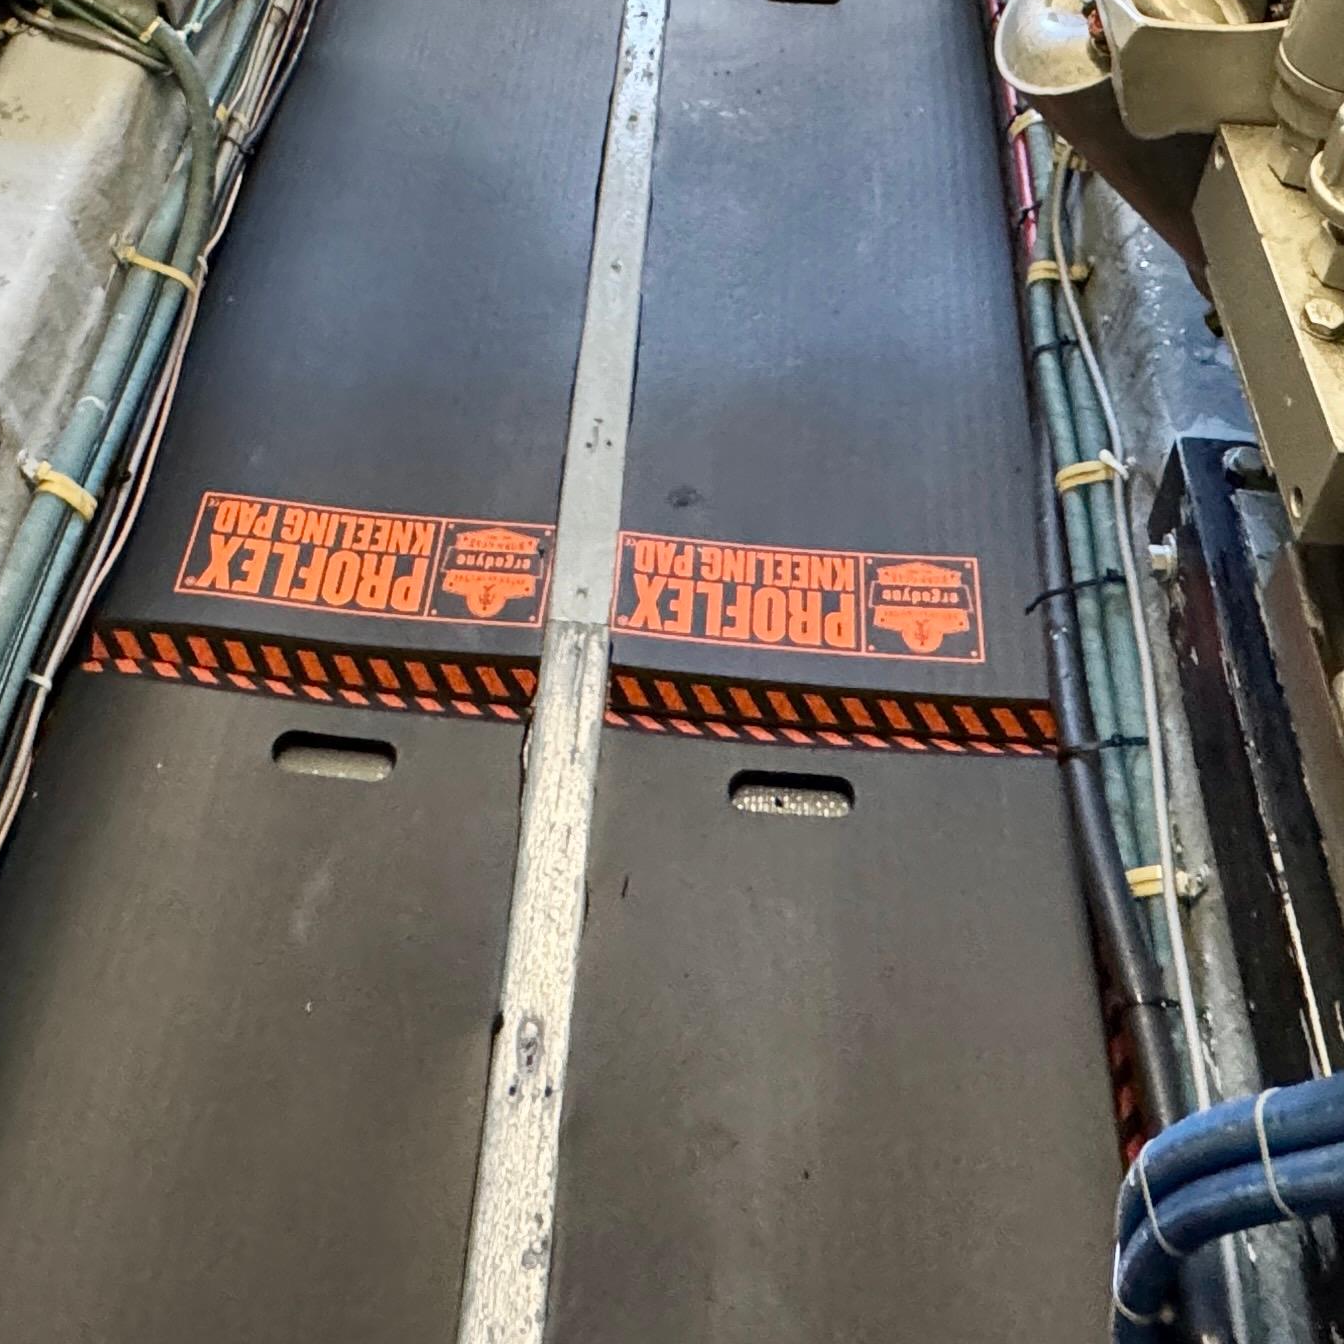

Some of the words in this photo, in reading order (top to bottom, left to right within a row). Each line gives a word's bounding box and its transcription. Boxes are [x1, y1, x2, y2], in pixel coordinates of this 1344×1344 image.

[212, 499, 278, 538] PAD
[280, 508, 436, 556] KNEELING
[195, 533, 430, 613] PROFLEX
[456, 553, 532, 572] ergodyne
[633, 539, 695, 577] PAD
[700, 546, 855, 592] KNEELING
[628, 573, 856, 649] PROFLEX
[881, 588, 960, 604] ergodyne
